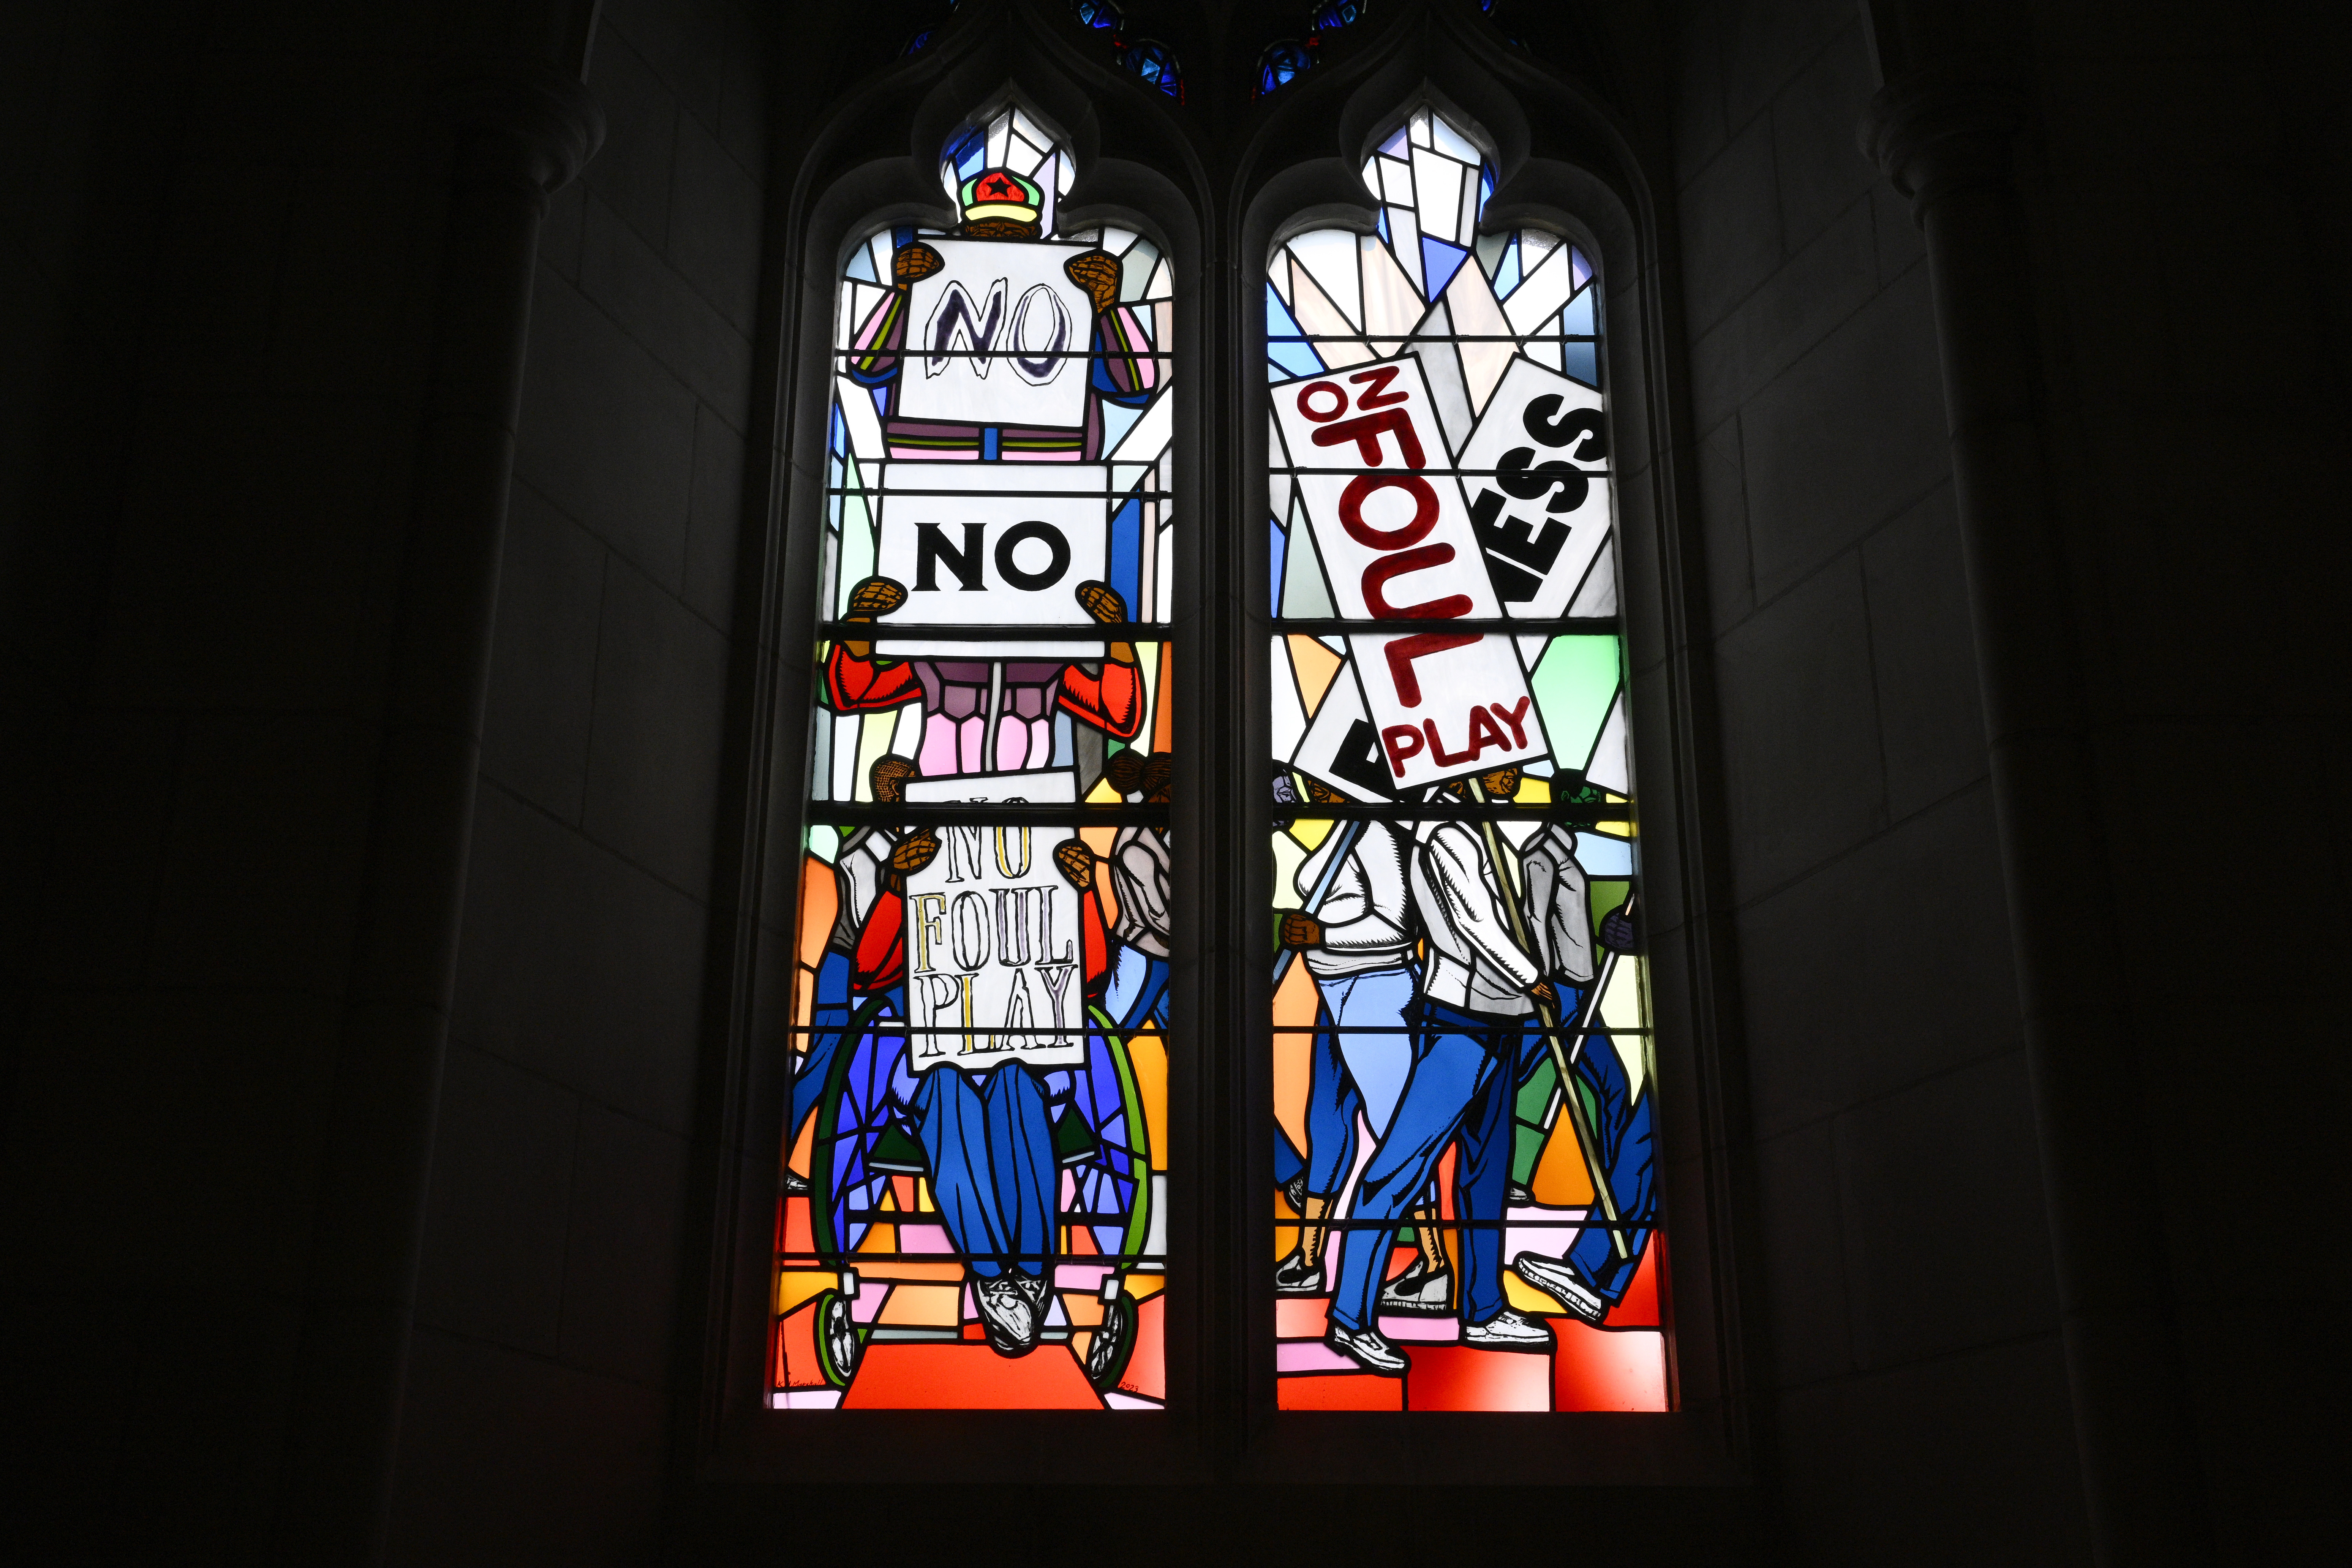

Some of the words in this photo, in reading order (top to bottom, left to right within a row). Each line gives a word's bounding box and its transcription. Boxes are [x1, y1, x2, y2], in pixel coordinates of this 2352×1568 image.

[924, 277, 1072, 386] NO
[1297, 365, 1409, 423] NO
[911, 521, 1071, 591] NO
[1311, 408, 1484, 708] FOUL
[1381, 696, 1530, 778] PLAY
[944, 797, 1031, 883] NO
[909, 885, 1074, 973] FOUL
[913, 964, 1079, 1057] PLAY
[1121, 1381, 1139, 1392] 2023
